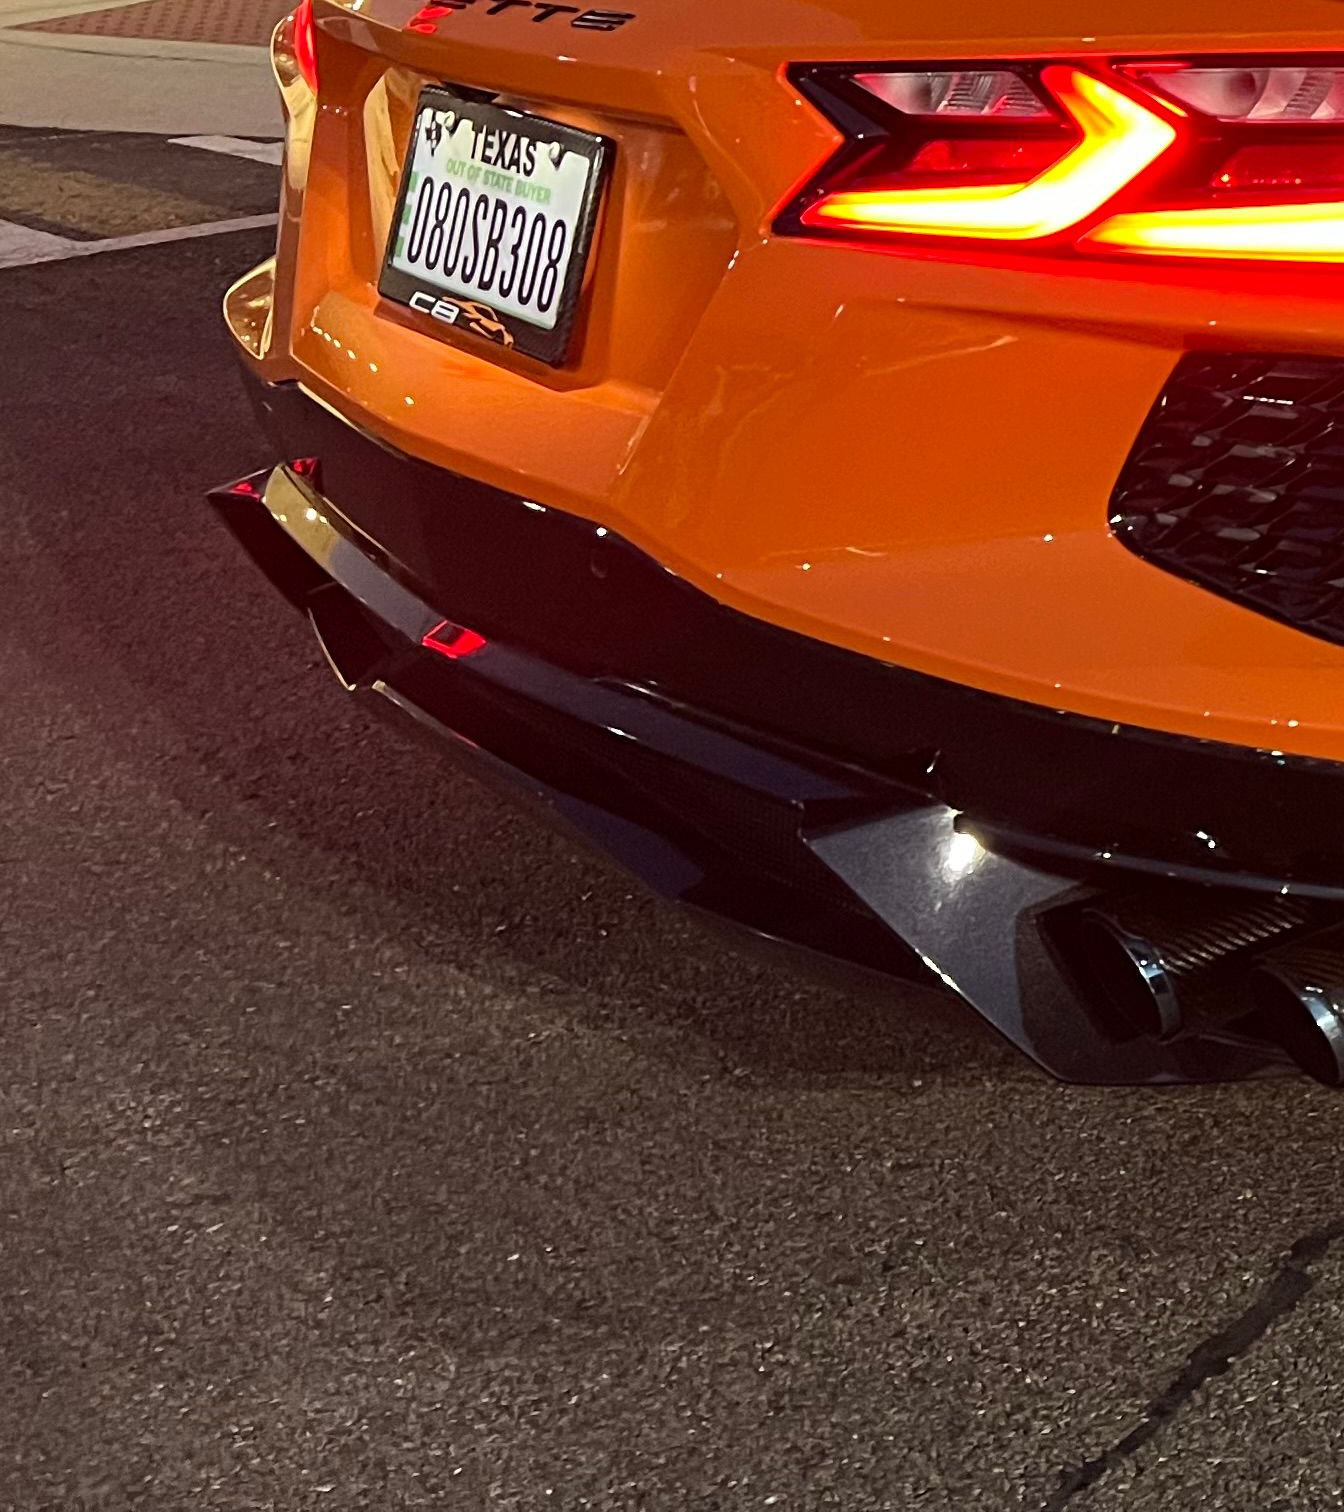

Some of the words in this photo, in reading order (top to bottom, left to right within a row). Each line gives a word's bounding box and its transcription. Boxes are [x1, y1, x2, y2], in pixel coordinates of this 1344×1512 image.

[470, 125, 538, 177] TEXAS
[446, 158, 465, 175] OUT
[466, 164, 483, 181] OF
[482, 168, 514, 194] STATE
[514, 178, 552, 205] BUYER
[406, 175, 567, 313] 080SB308
[408, 290, 460, 324] C8
